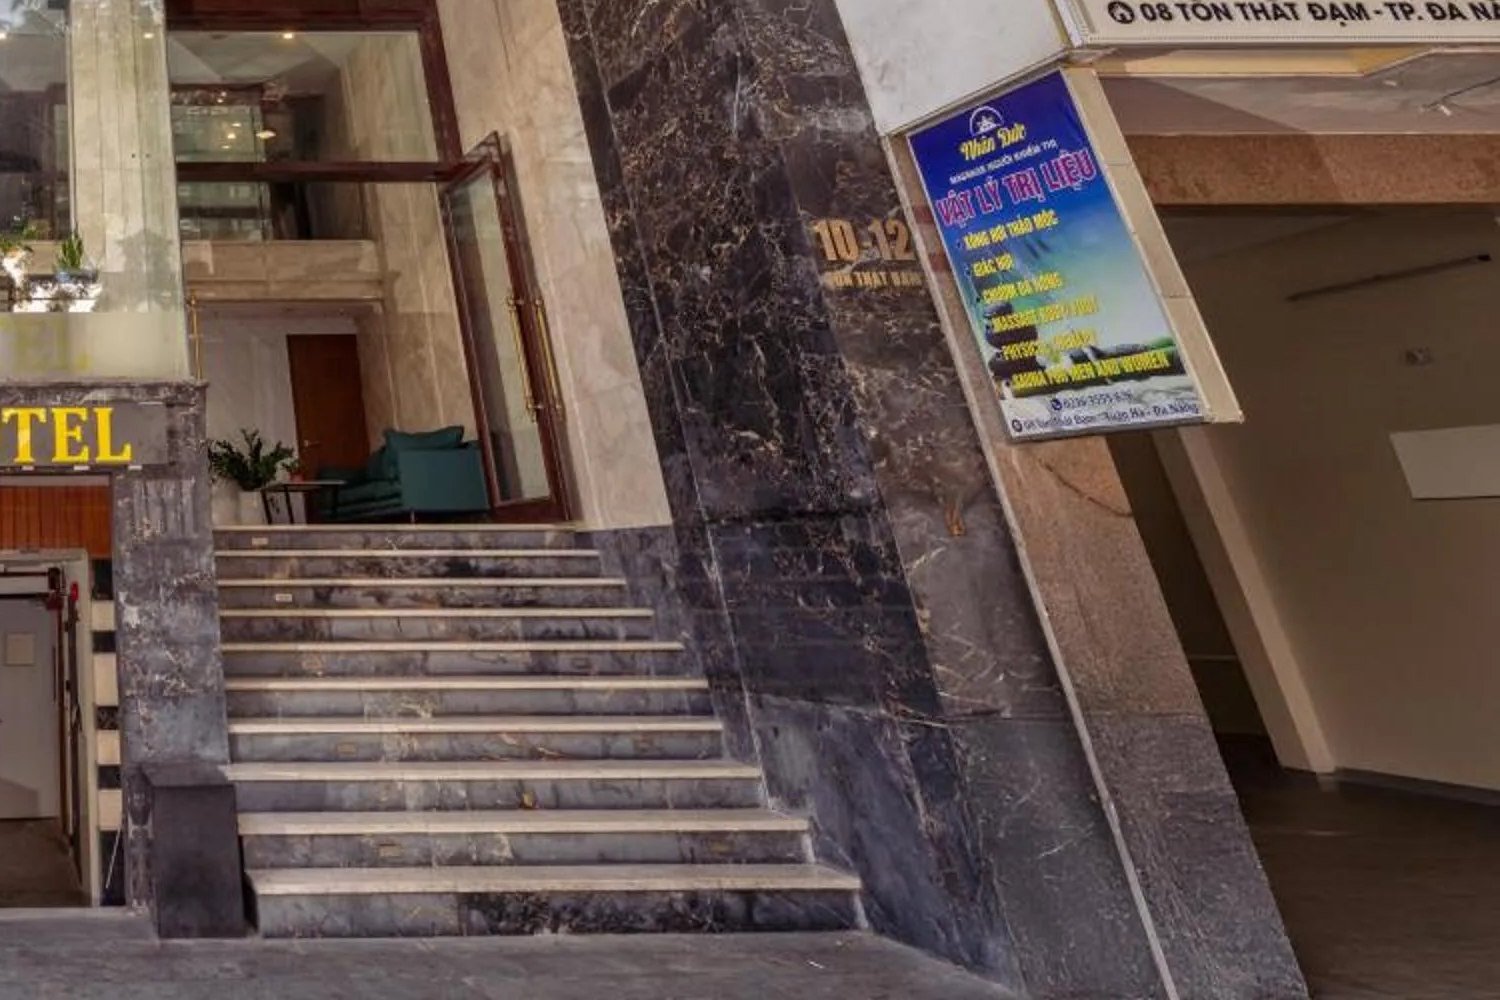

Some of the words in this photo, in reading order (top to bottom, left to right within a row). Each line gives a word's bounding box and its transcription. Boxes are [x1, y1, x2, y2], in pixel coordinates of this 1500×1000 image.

[1141, 2, 1173, 22] 08
[1310, 0, 1371, 28] ĐẠM
[1383, 1, 1423, 22] TP.
[936, 189, 976, 228] VẬT
[974, 175, 1002, 214] LÝ
[1002, 167, 1046, 203] TRỊ
[1040, 148, 1097, 192] LIỆU
